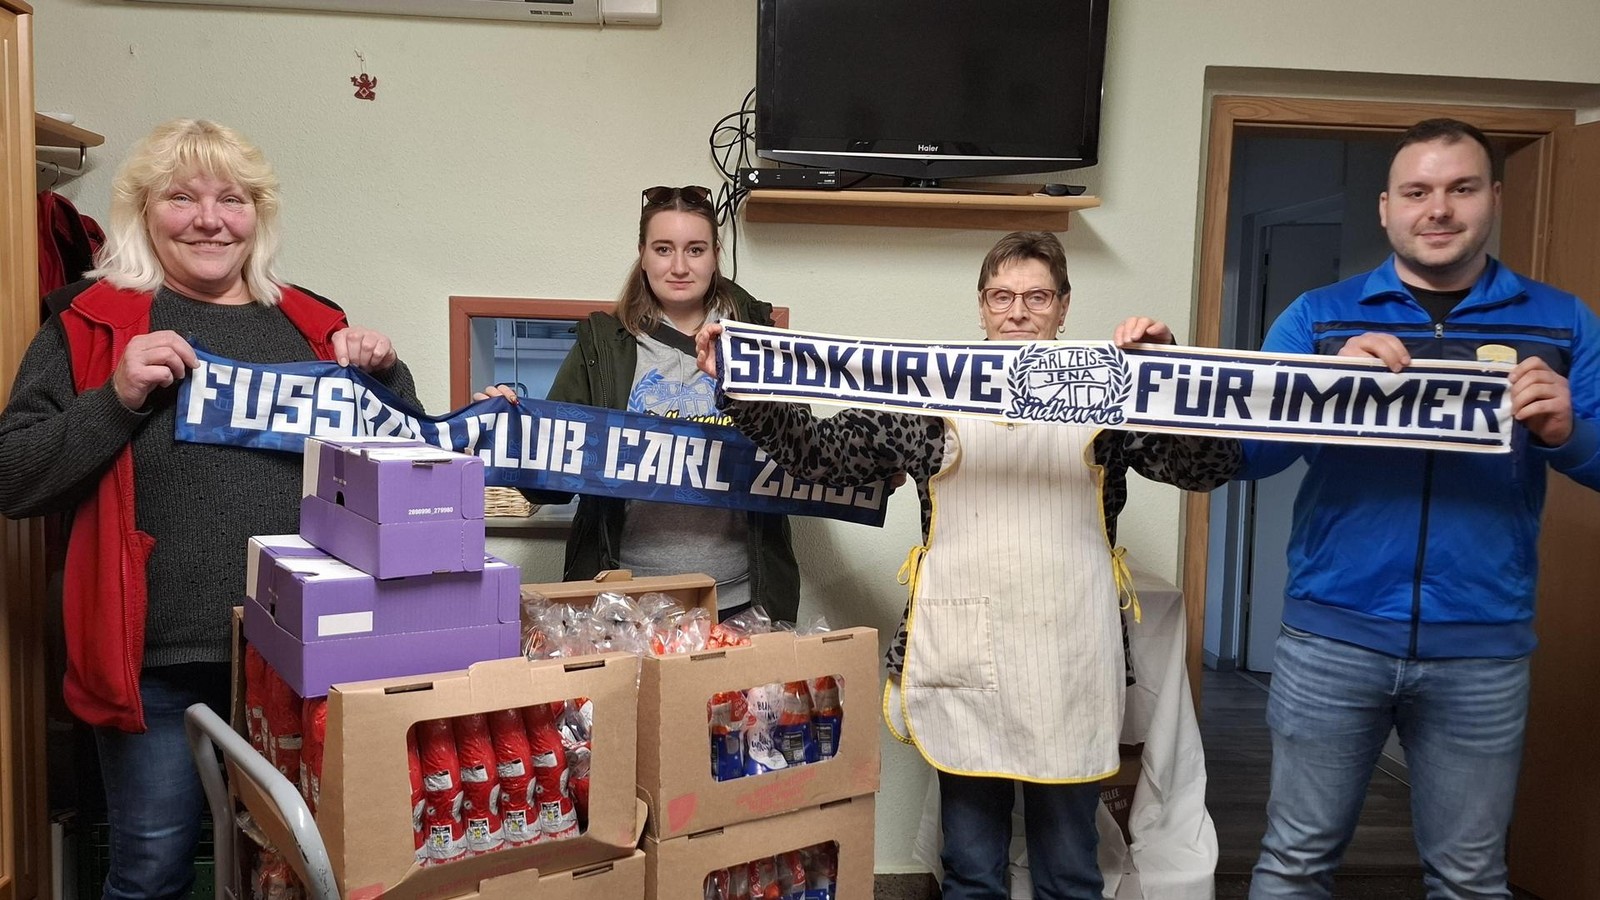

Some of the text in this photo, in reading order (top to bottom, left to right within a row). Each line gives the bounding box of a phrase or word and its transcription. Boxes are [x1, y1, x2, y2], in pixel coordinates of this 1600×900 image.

[917, 144, 939, 152] Haier
[730, 336, 1510, 433] SÜDKURVE FÜR IMMER
[1044, 370, 1095, 383] JENA
[1006, 396, 1124, 425] Südkurve
[603, 426, 730, 492] CARL
